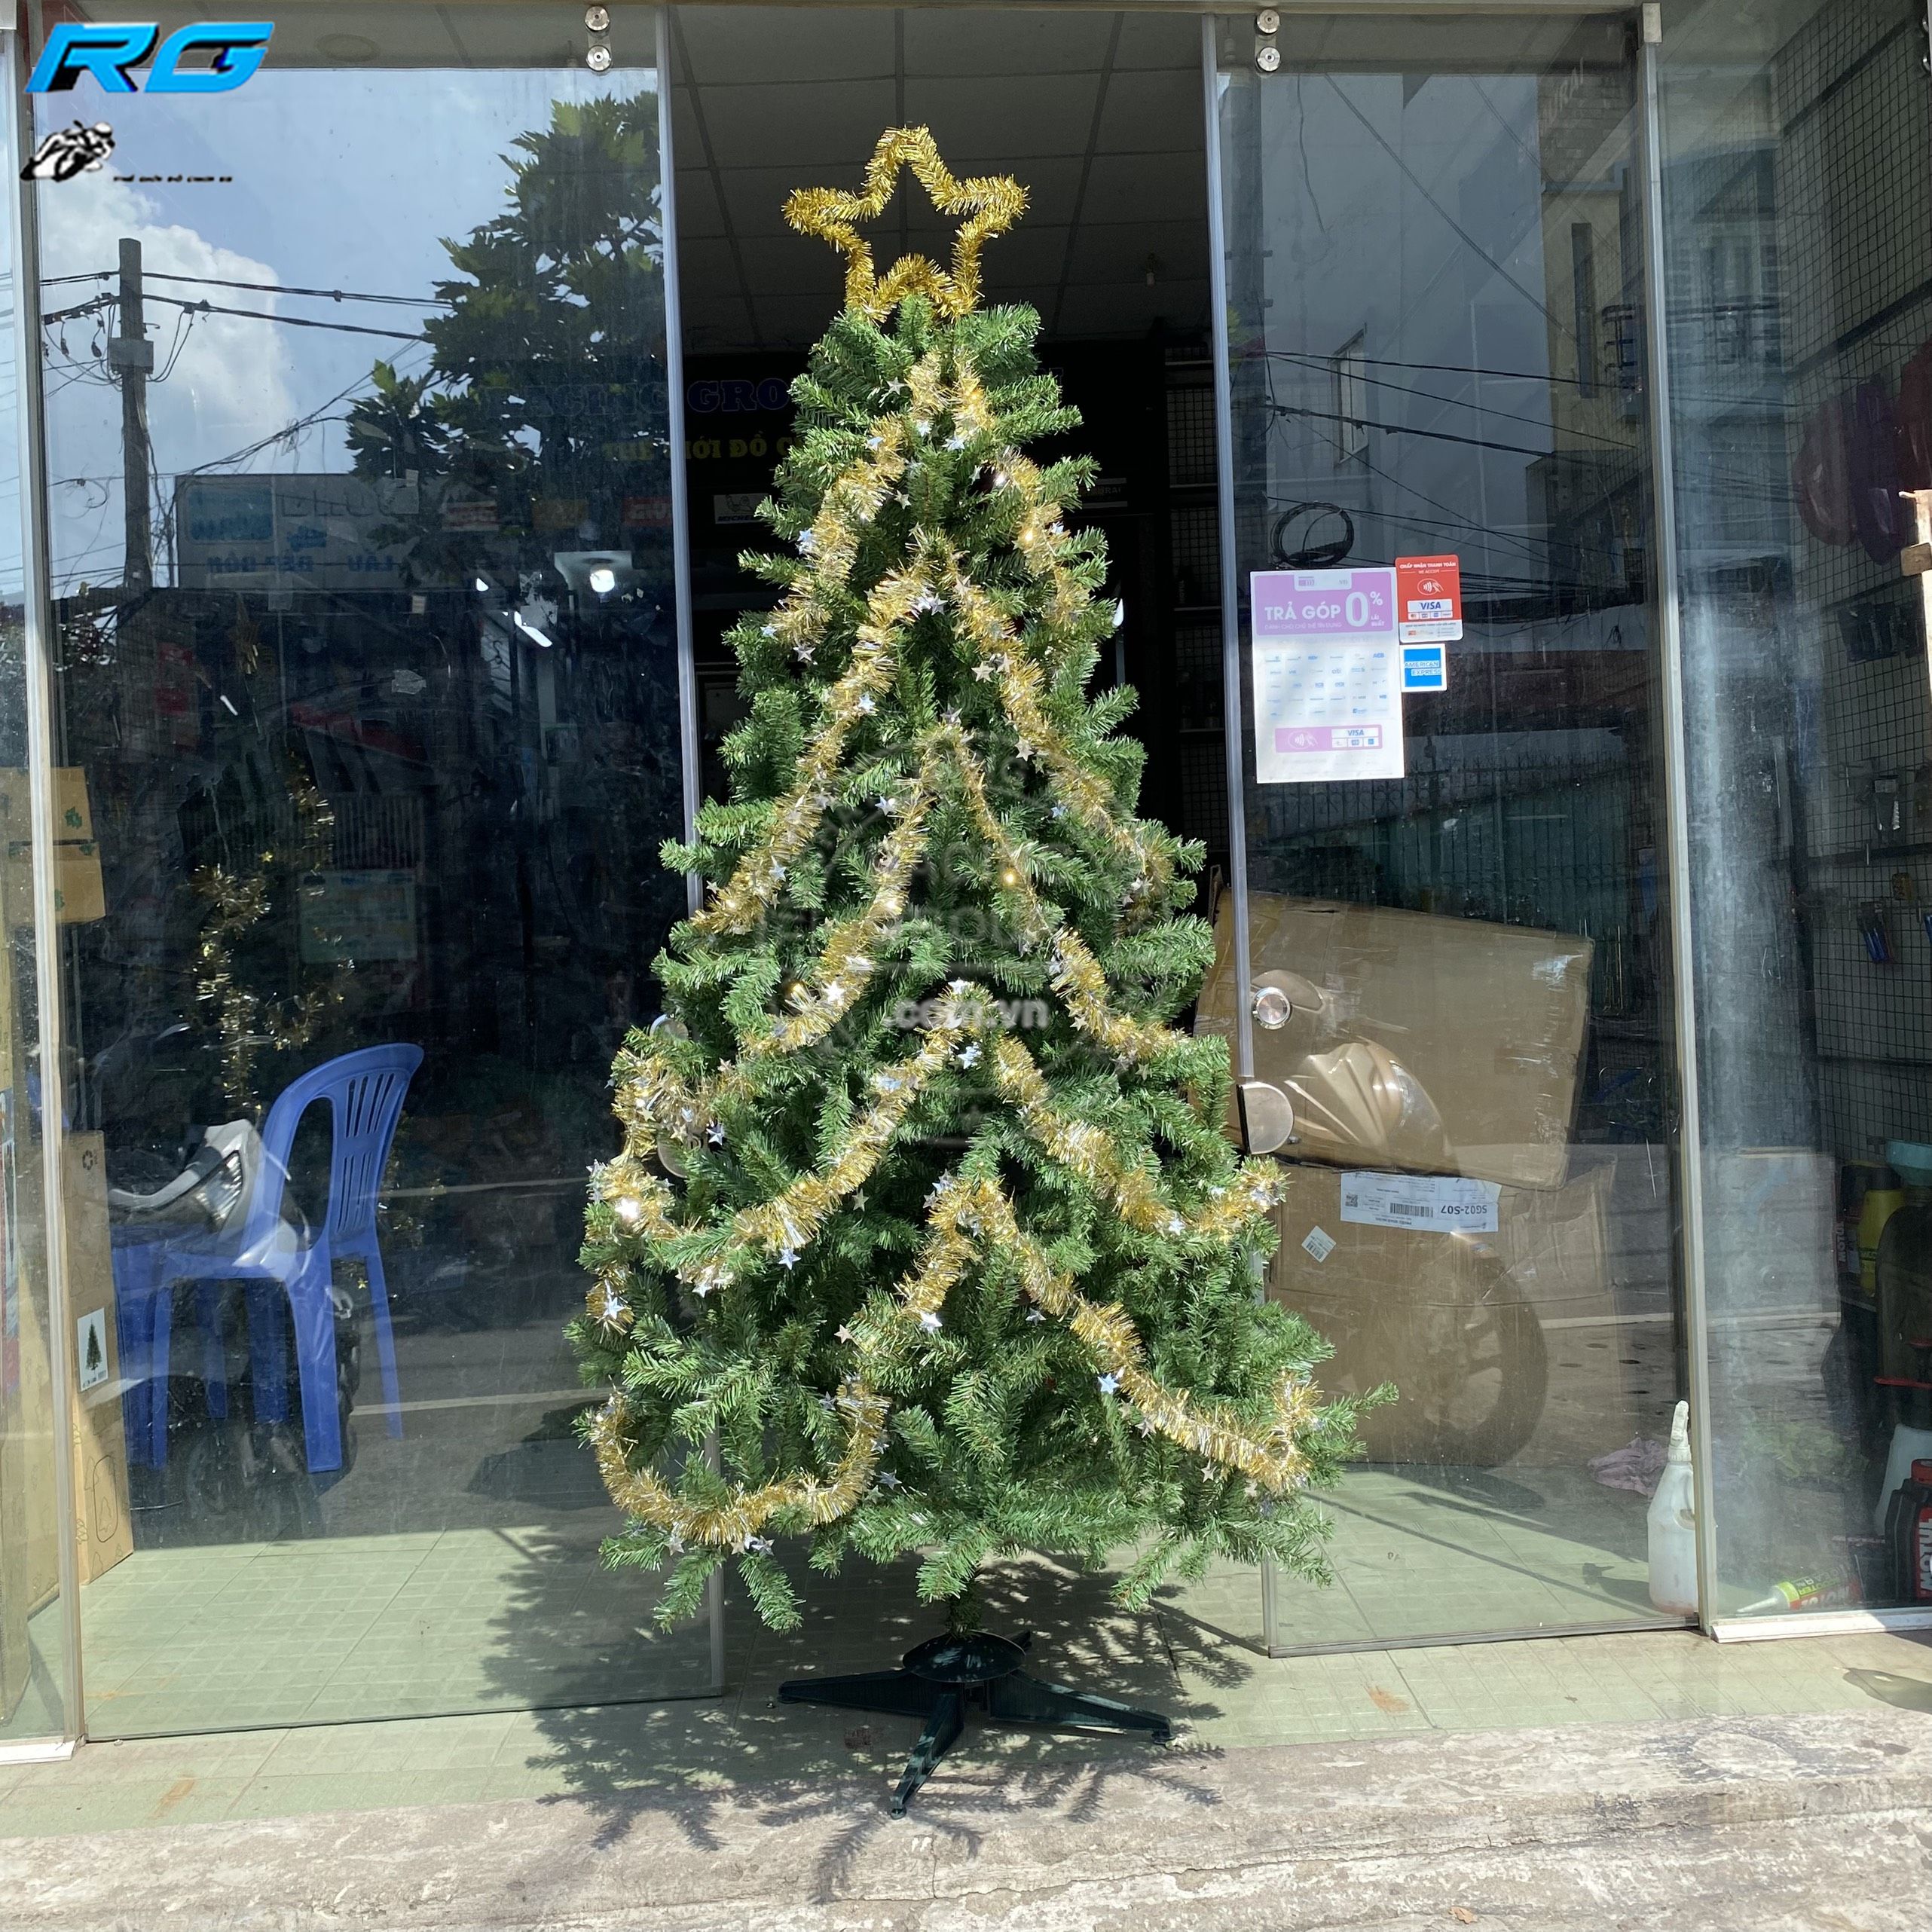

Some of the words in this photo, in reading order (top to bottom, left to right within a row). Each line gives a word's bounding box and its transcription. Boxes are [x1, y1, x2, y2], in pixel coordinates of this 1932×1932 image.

[687, 378, 790, 412] GRO
[1264, 602, 1297, 621] TRẢ
[1302, 601, 1341, 619] GÓP
[1420, 601, 1441, 610] VISA
[1441, 1204, 1487, 1215] SG02-S07
